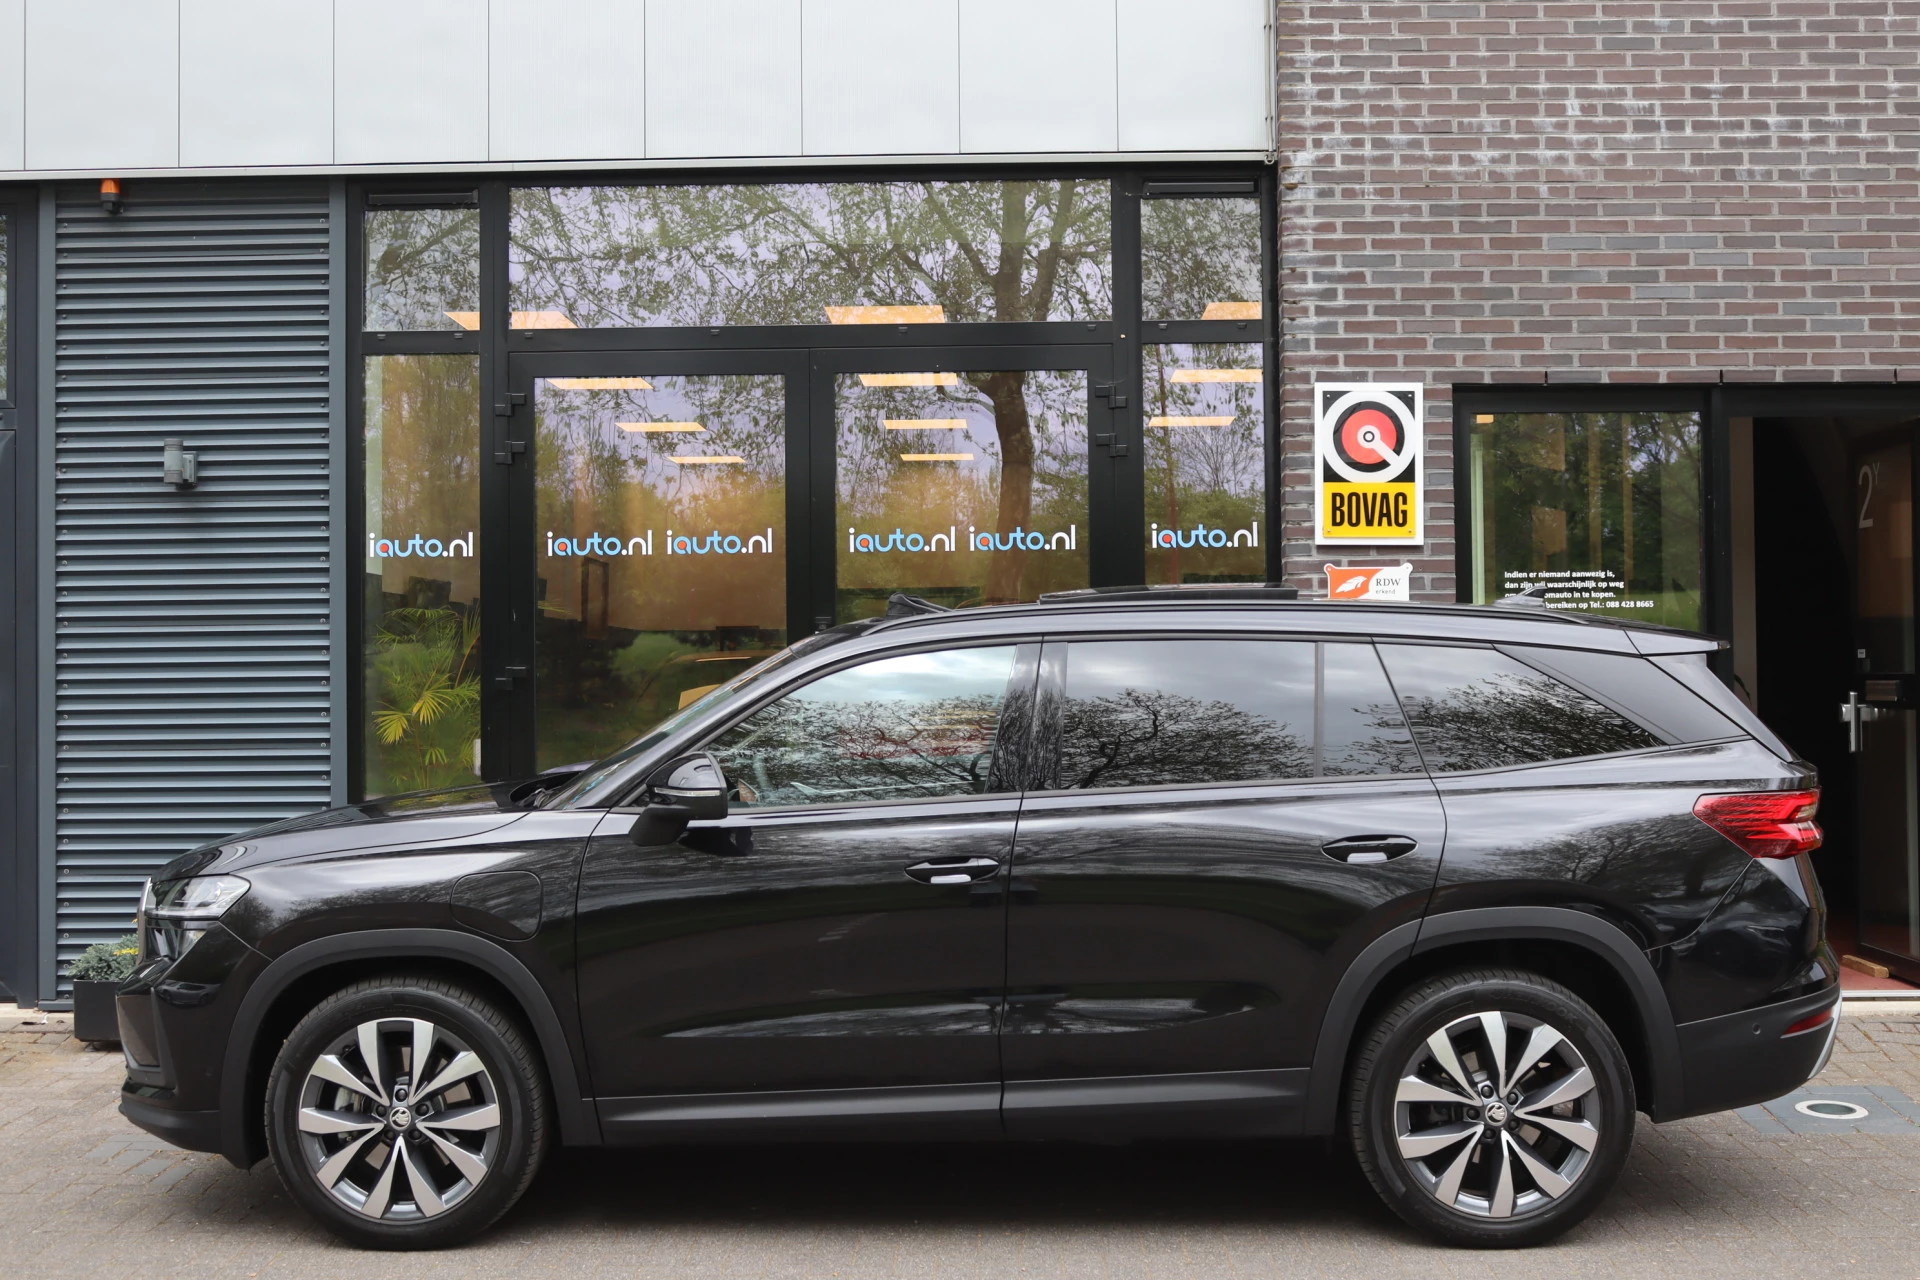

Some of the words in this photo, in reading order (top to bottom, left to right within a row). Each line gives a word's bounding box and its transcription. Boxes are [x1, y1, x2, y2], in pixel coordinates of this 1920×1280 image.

[1331, 491, 1408, 528] BOVAG
[547, 529, 653, 557] iauto.nl
[666, 527, 772, 555] iauto.nl
[848, 525, 956, 553] iauto.nl
[969, 523, 1076, 551] iauto.nl
[1151, 521, 1258, 549] iauto.nl
[369, 531, 474, 559] iauto.nl
[1375, 578, 1402, 587] RDW
[1504, 571, 1528, 579] Indien
[1538, 570, 1570, 578] niemand
[1572, 570, 1606, 579] aanwezig
[1606, 570, 1616, 578] is,
[1504, 581, 1519, 589] dan
[1546, 580, 1597, 590] waarschijnlijk
[1608, 581, 1624, 589] weg
[1591, 591, 1616, 599] kopen.
[1545, 601, 1577, 609] bereiken
[1578, 602, 1588, 610] op
[1620, 600, 1635, 608] 428
[1636, 600, 1654, 608] 8665
